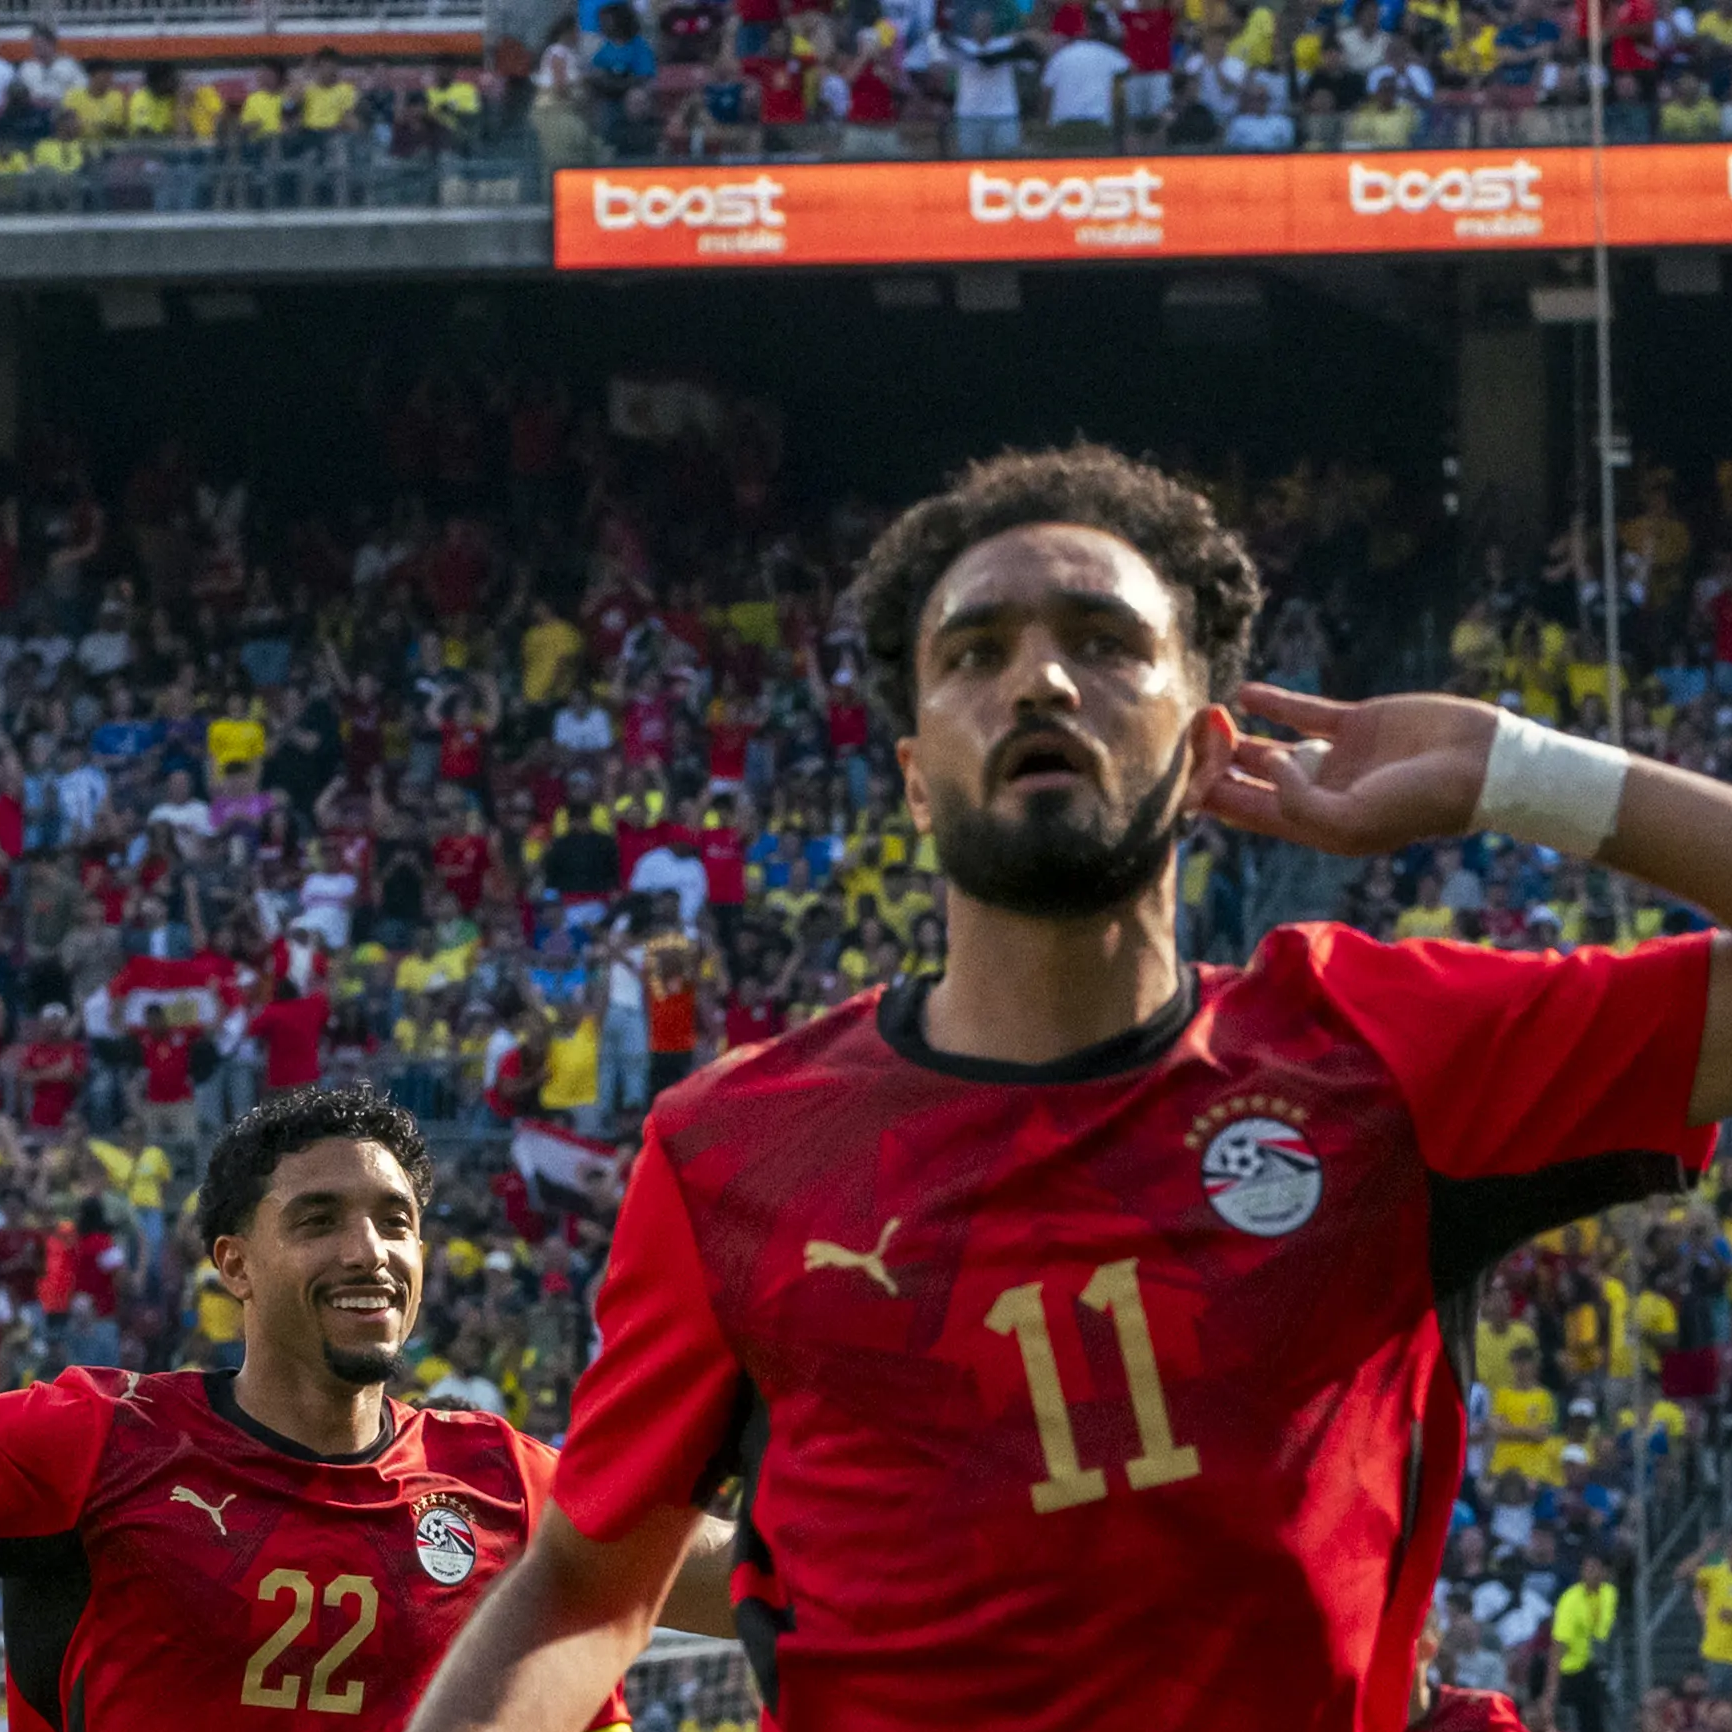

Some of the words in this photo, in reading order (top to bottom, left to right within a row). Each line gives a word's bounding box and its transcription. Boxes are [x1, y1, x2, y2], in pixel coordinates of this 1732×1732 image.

[593, 174, 786, 230] boost
[969, 166, 1163, 222] boost
[1349, 157, 1542, 214] boost
[984, 1258, 1201, 1513] 11
[241, 1568, 379, 1715] 22
